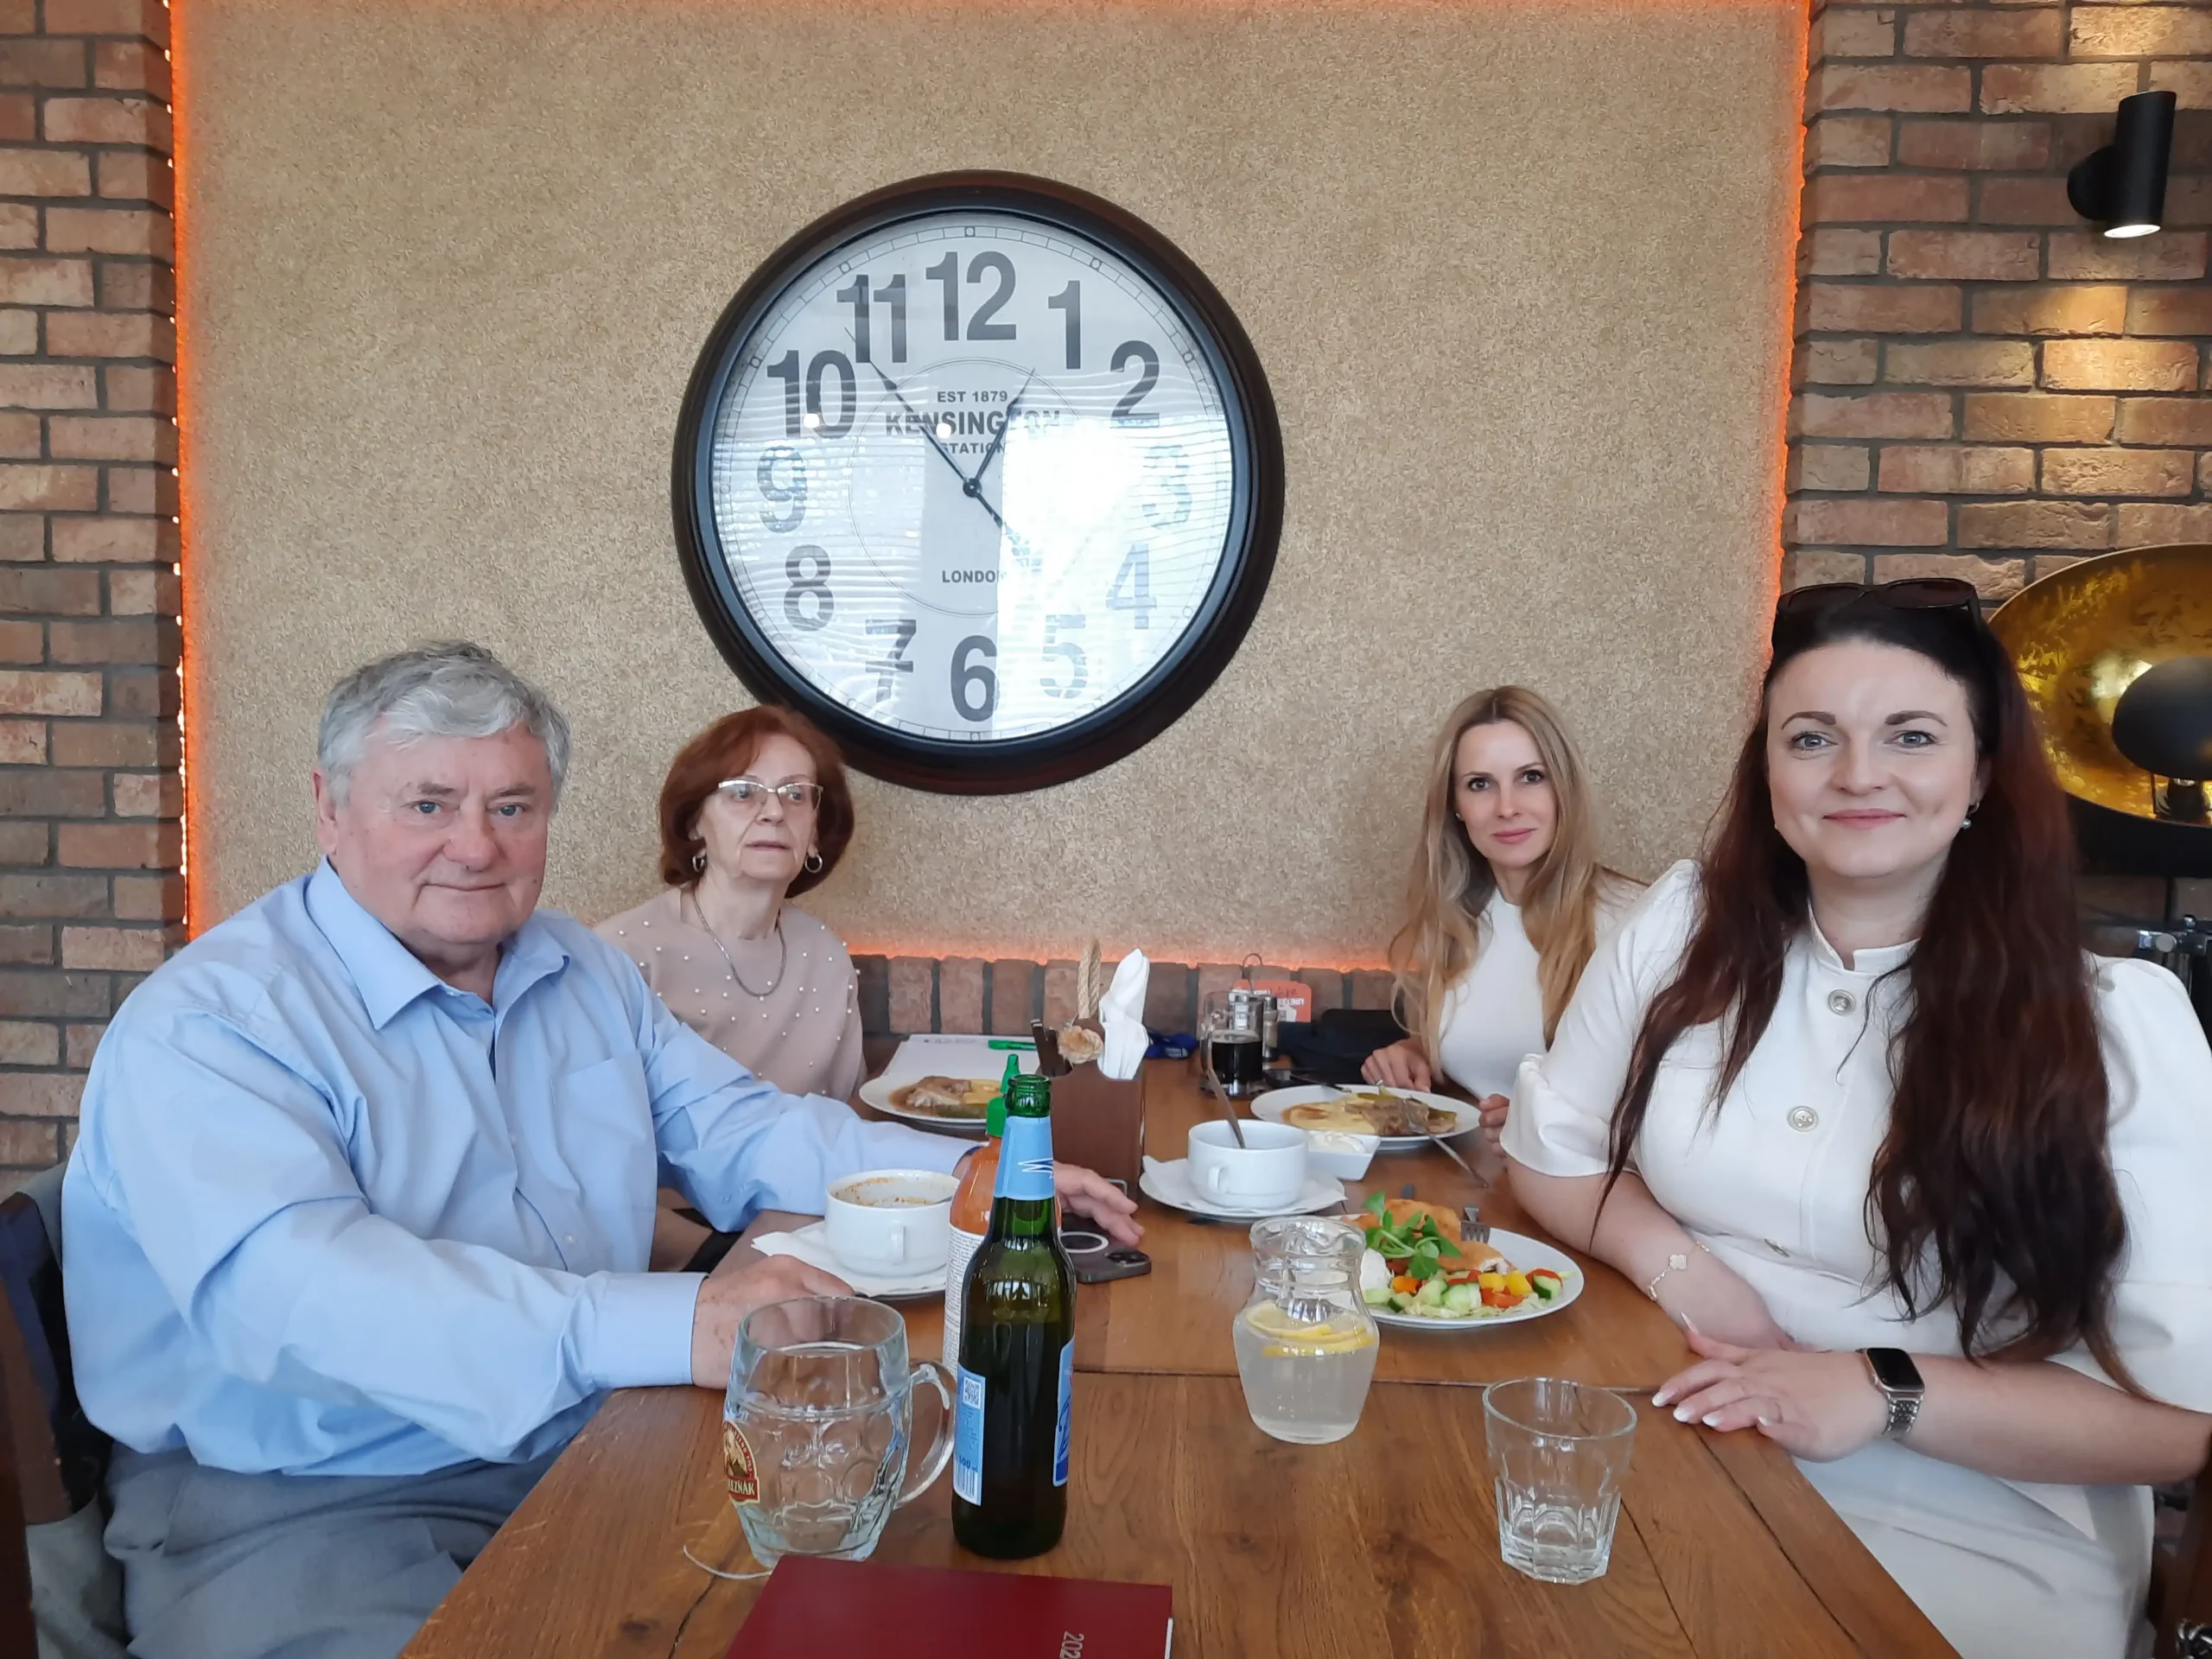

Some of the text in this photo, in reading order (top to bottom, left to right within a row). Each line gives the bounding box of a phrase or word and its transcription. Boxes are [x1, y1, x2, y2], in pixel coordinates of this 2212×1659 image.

[836, 274, 907, 364] 11
[925, 251, 1017, 341] 12
[1047, 280, 1081, 370] 1
[766, 349, 857, 440] 10
[937, 391, 1008, 403] EST 1879
[1110, 340, 1160, 429] 2
[756, 446, 808, 533] 9
[784, 543, 835, 632] 8
[1105, 543, 1157, 630] 4
[865, 619, 917, 703] 7
[950, 634, 1001, 722] 6
[1039, 614, 1089, 699] 5
